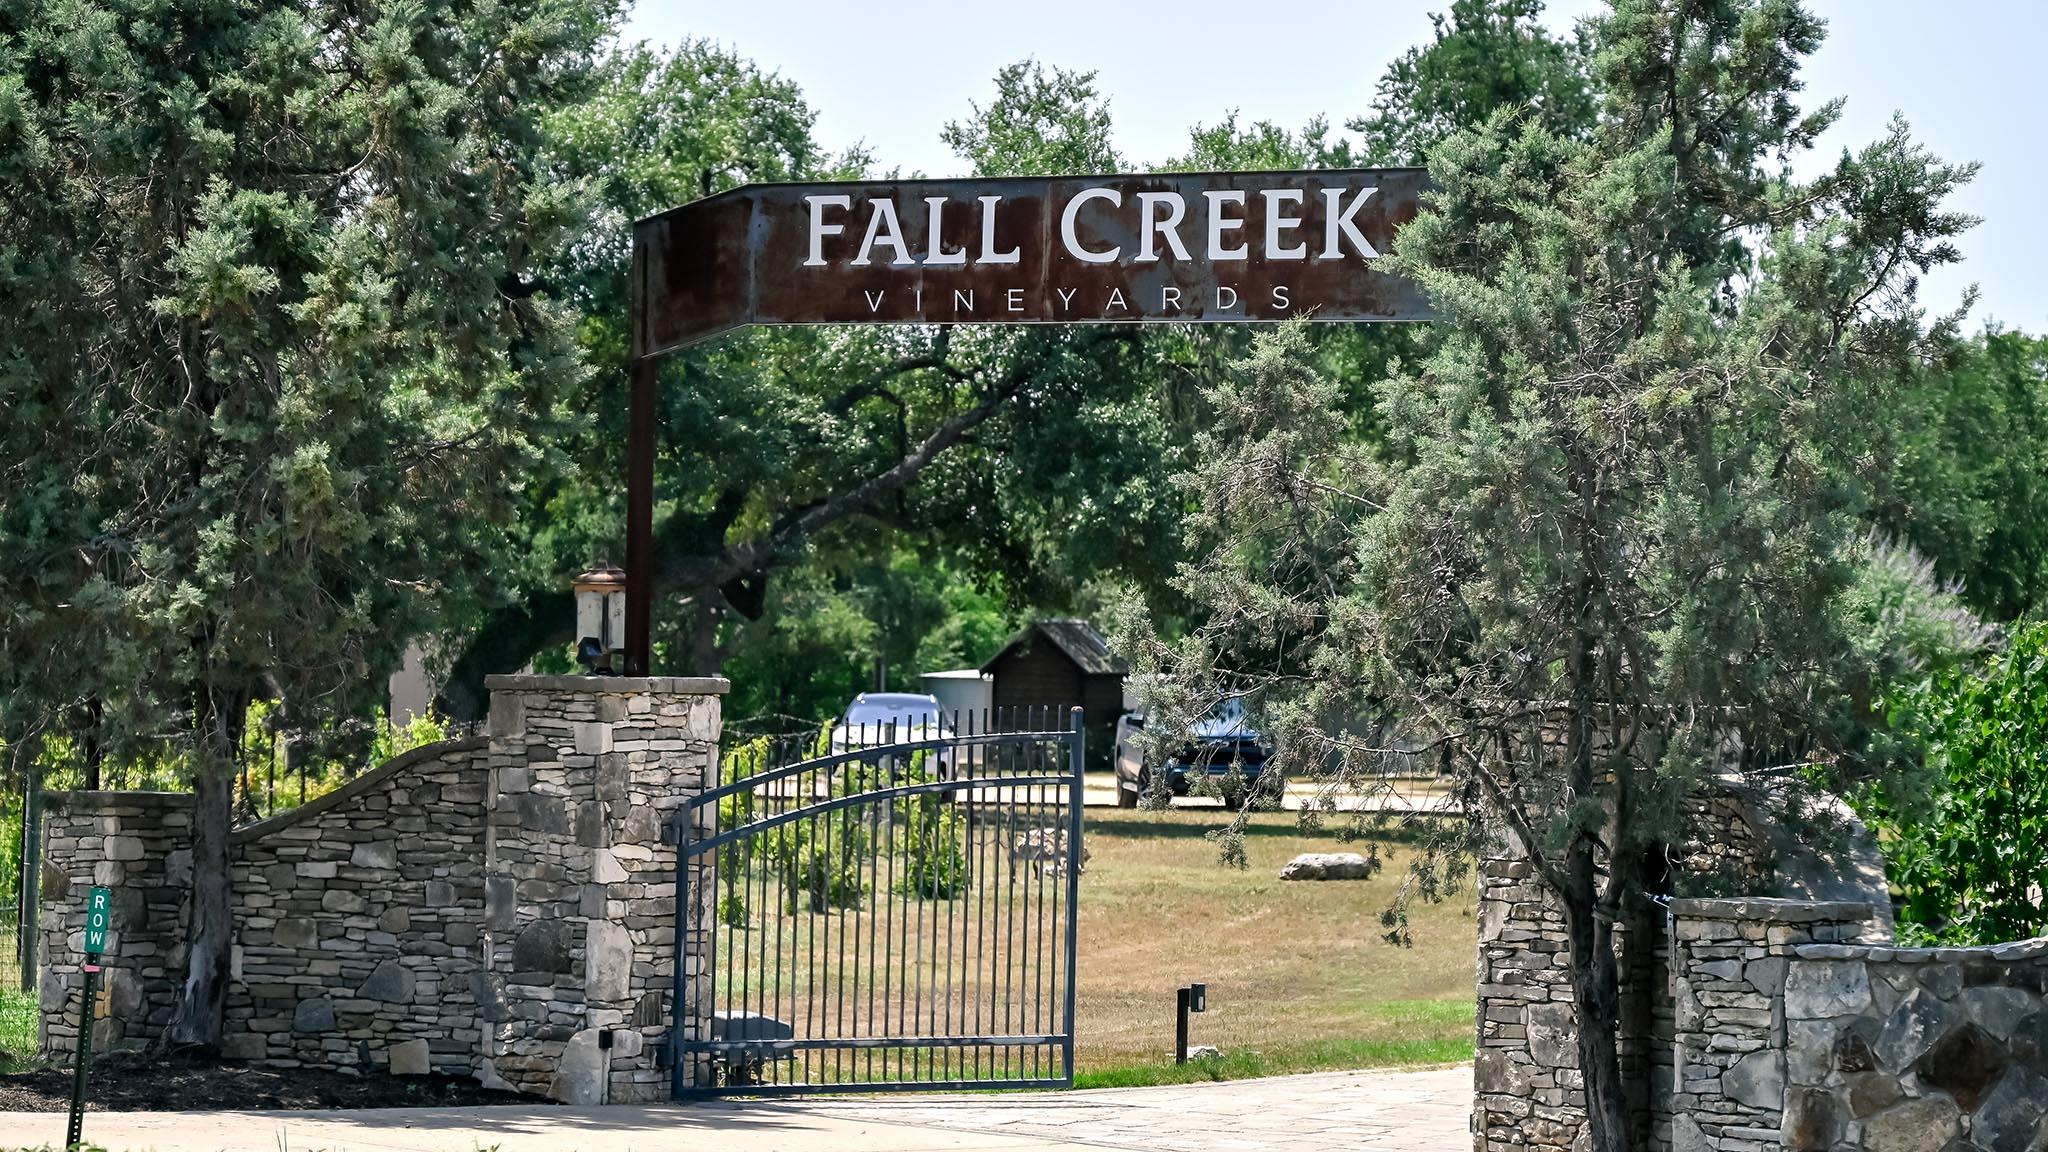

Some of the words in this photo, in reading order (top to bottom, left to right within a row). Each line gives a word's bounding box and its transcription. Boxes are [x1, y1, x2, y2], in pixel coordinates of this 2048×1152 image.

[802, 194, 1021, 267] FALL
[1060, 186, 1379, 264] CREEK
[864, 285, 1291, 313] VINEYARDS
[90, 895, 105, 946] ROW
